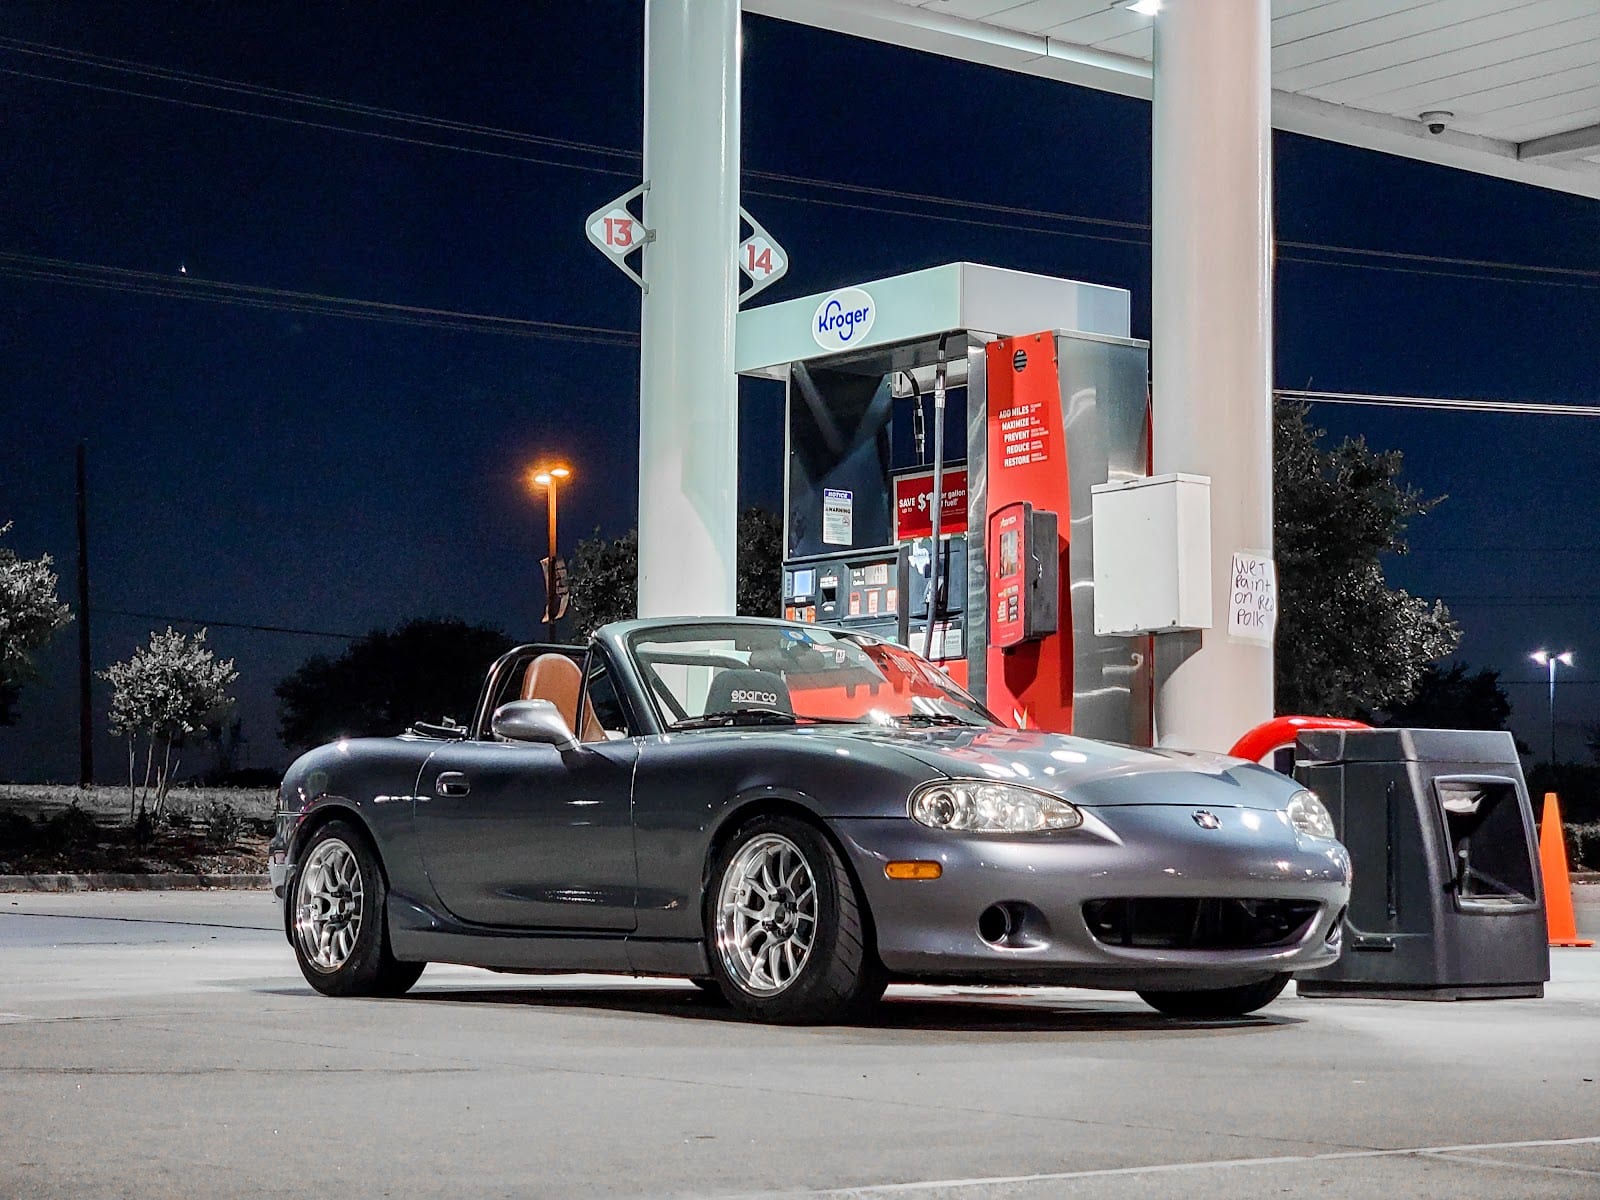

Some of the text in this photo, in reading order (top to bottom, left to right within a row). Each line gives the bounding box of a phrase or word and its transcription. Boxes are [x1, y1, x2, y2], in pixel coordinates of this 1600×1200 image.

[603, 218, 633, 246] 13
[747, 245, 773, 274] 14
[819, 300, 869, 341] Kroger
[999, 409, 1012, 420] ADD
[1012, 405, 1029, 417] MILES
[1001, 417, 1029, 431] MAXIMIZE
[1004, 430, 1030, 442] PREVENT
[1006, 442, 1030, 454] REDUCE
[1004, 454, 1030, 467] RESTORE
[828, 491, 848, 499] NOTICE
[948, 489, 966, 500] gallon
[899, 498, 916, 508] SAVE
[829, 506, 851, 514] WARNING
